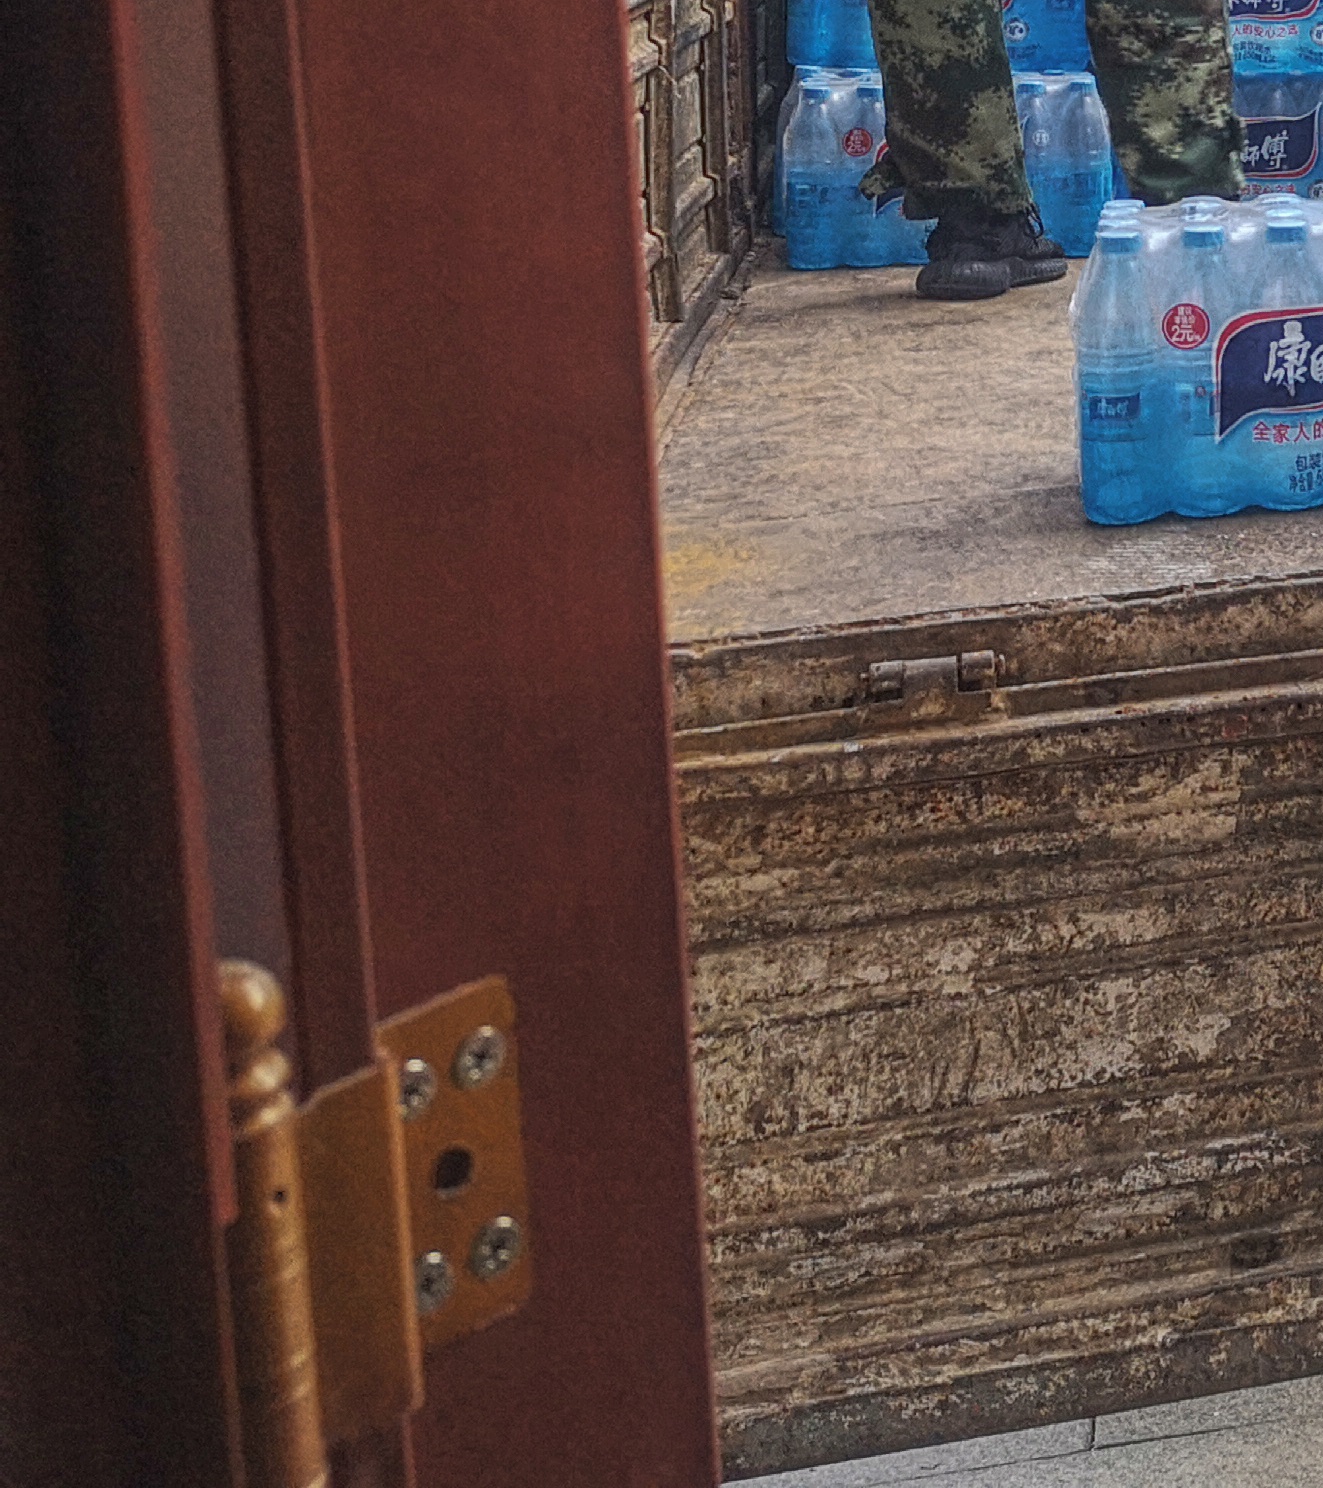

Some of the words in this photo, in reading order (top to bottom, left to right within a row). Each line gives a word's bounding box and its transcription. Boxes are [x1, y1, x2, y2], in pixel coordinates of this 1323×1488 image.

[1231, 24, 1299, 39] 人的安心之选
[1240, 130, 1289, 170] 師傅
